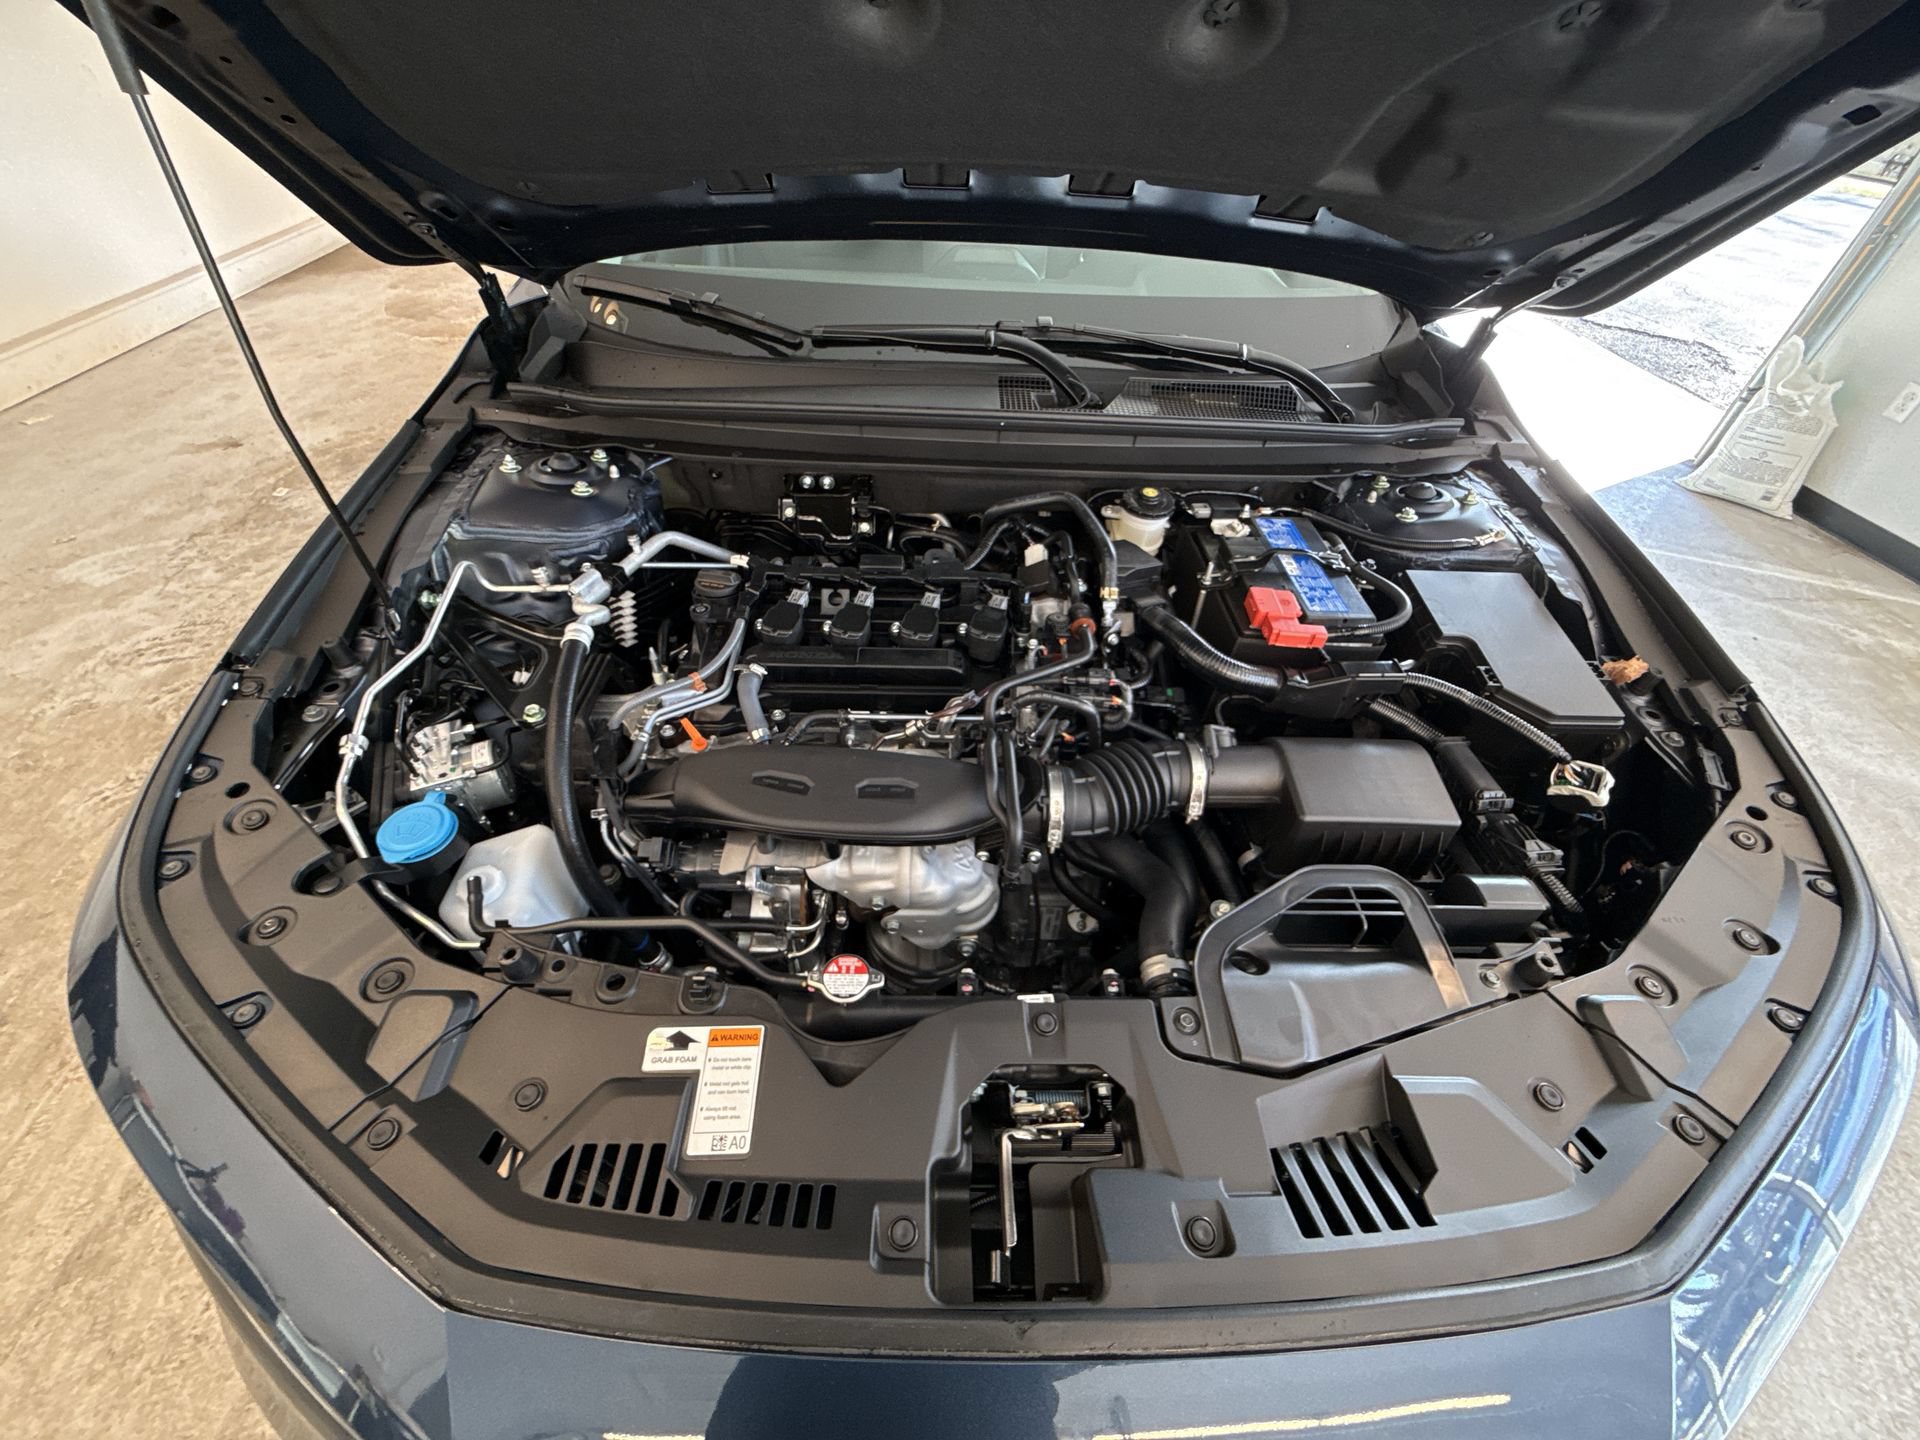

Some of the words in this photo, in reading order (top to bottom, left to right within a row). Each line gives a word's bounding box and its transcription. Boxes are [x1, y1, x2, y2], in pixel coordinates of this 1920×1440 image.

[720, 1033, 759, 1041] WARNING
[651, 1056, 673, 1064] GRAB
[674, 1055, 698, 1063] FOAM
